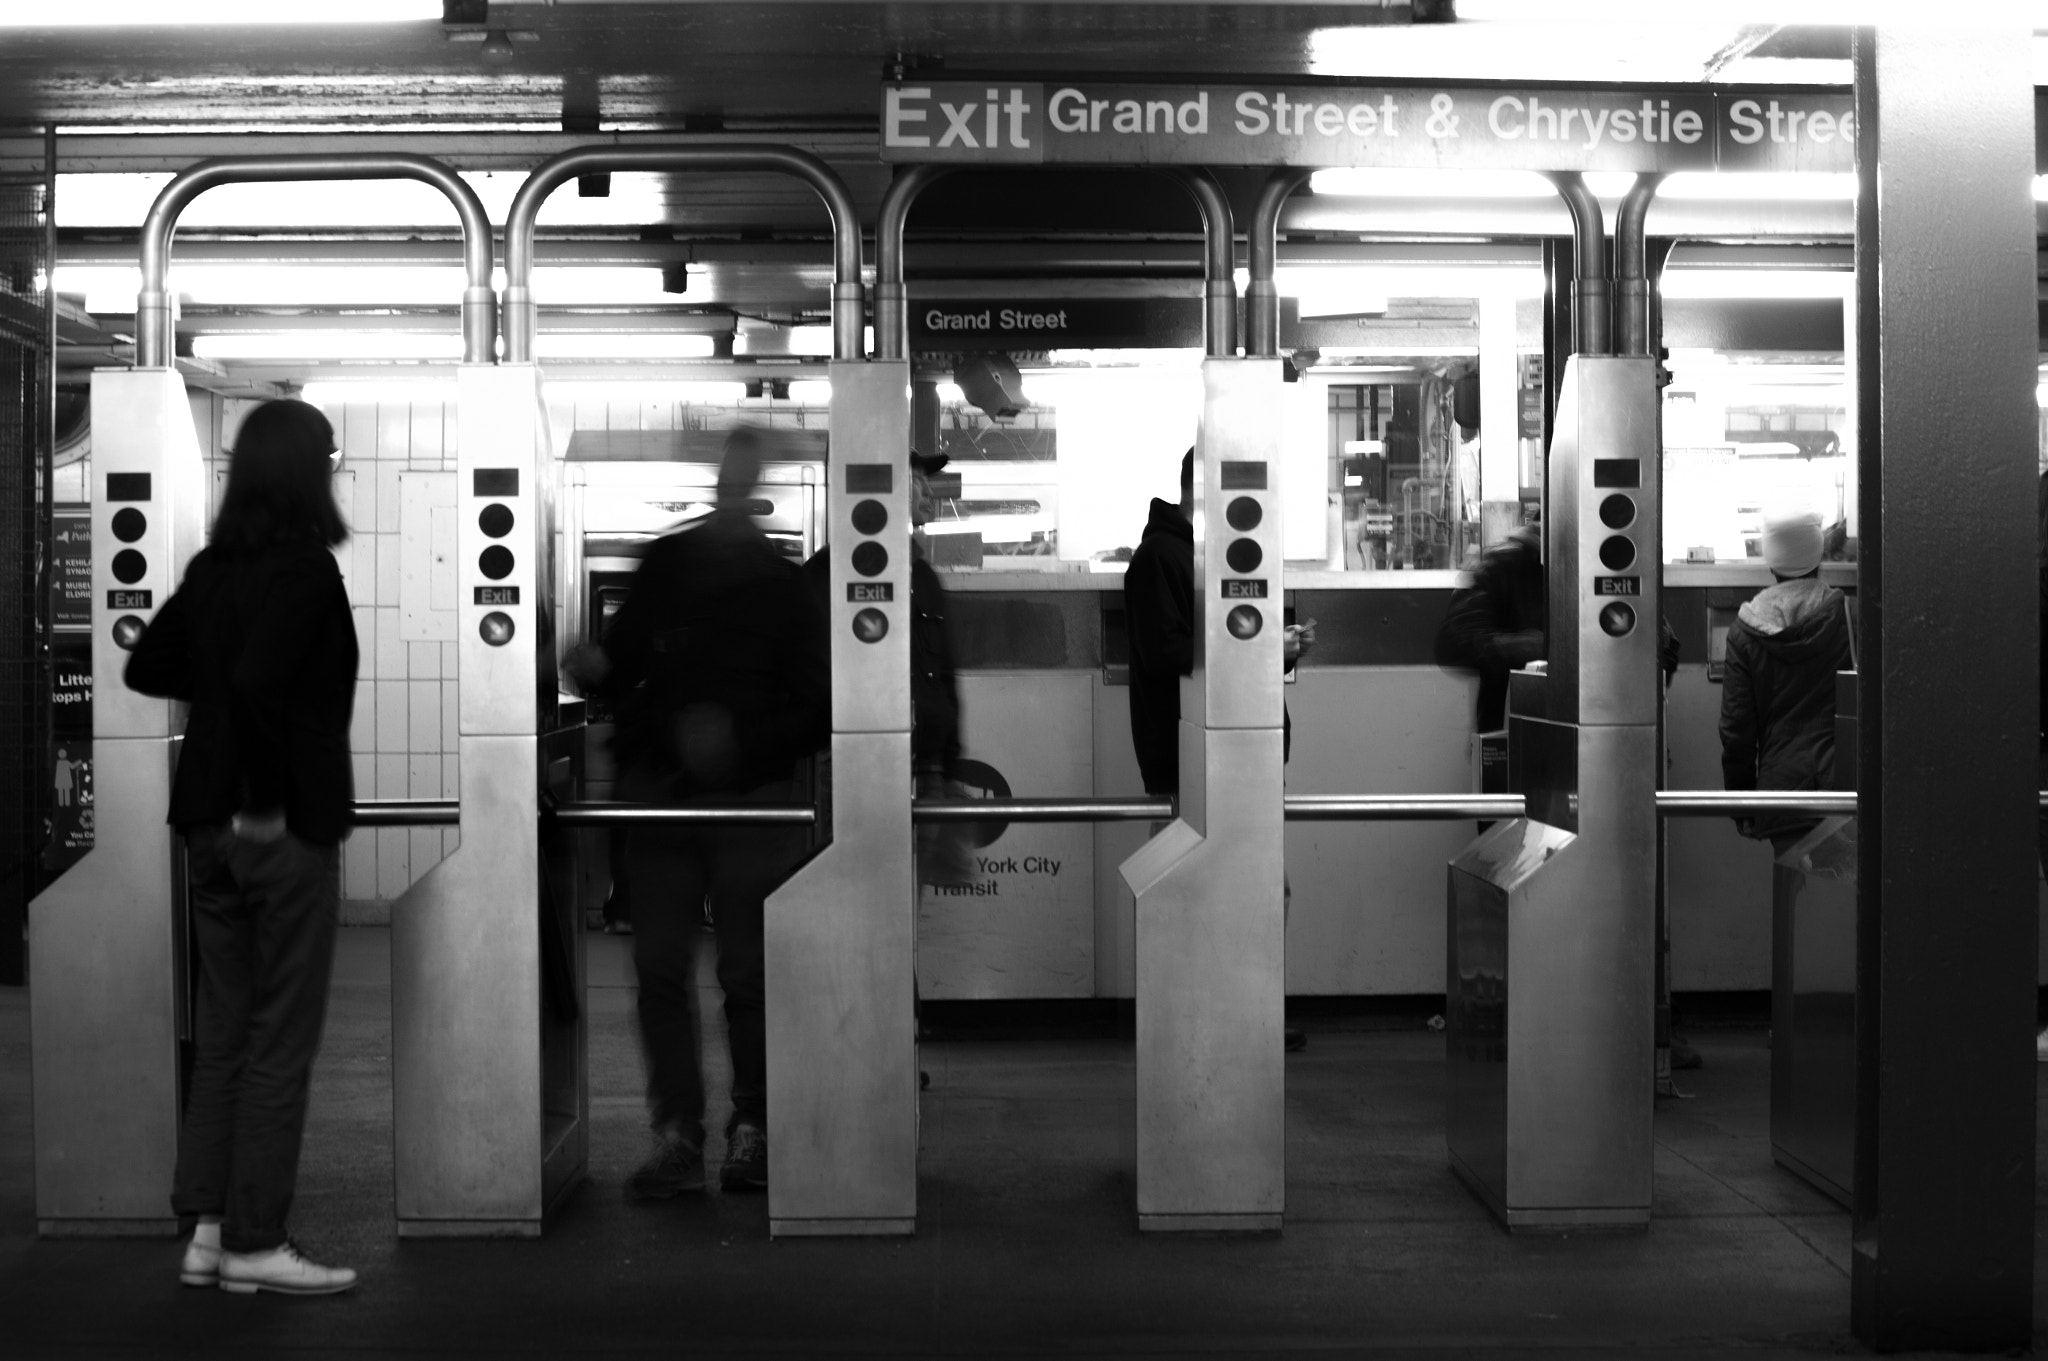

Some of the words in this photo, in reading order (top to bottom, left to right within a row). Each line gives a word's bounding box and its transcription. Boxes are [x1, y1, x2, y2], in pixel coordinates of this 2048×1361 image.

[885, 87, 1031, 148] Exit
[1048, 87, 1209, 134] Grand
[1234, 90, 1399, 137] Street
[1424, 92, 1460, 138] &
[1488, 95, 1704, 151] Chrystie
[925, 310, 990, 330] Grand
[999, 309, 1067, 329] Street
[854, 585, 886, 600] Exit
[1228, 582, 1260, 597] Exit
[1601, 579, 1632, 594] Exit
[114, 592, 145, 608] Exit
[481, 588, 512, 604] Exit
[977, 857, 1018, 874] York
[1023, 857, 1062, 877] City
